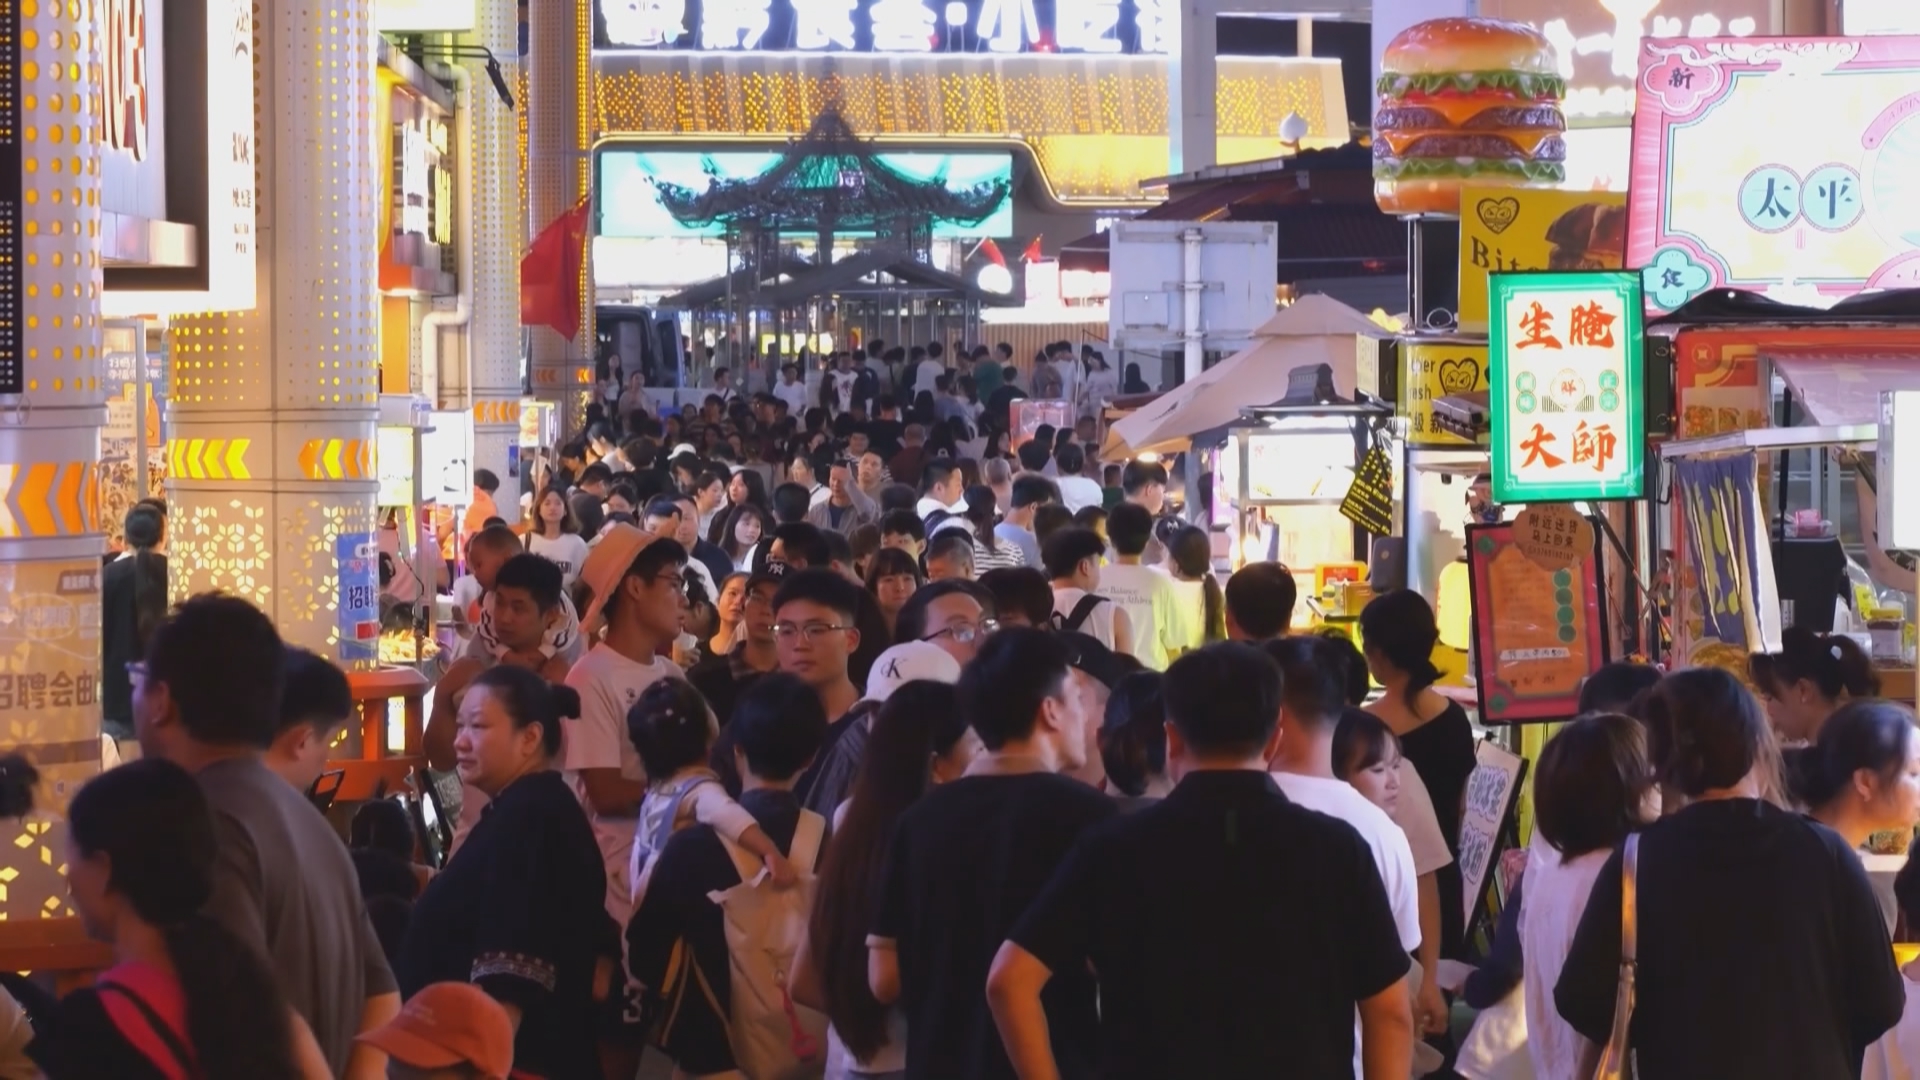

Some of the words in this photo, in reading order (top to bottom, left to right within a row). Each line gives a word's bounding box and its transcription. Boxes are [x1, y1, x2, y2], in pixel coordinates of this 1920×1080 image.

[1668, 67, 1695, 90] 新
[1751, 177, 1854, 220] 太平
[1471, 235, 1541, 270] Bit
[1532, 529, 1574, 548] 马上回来
